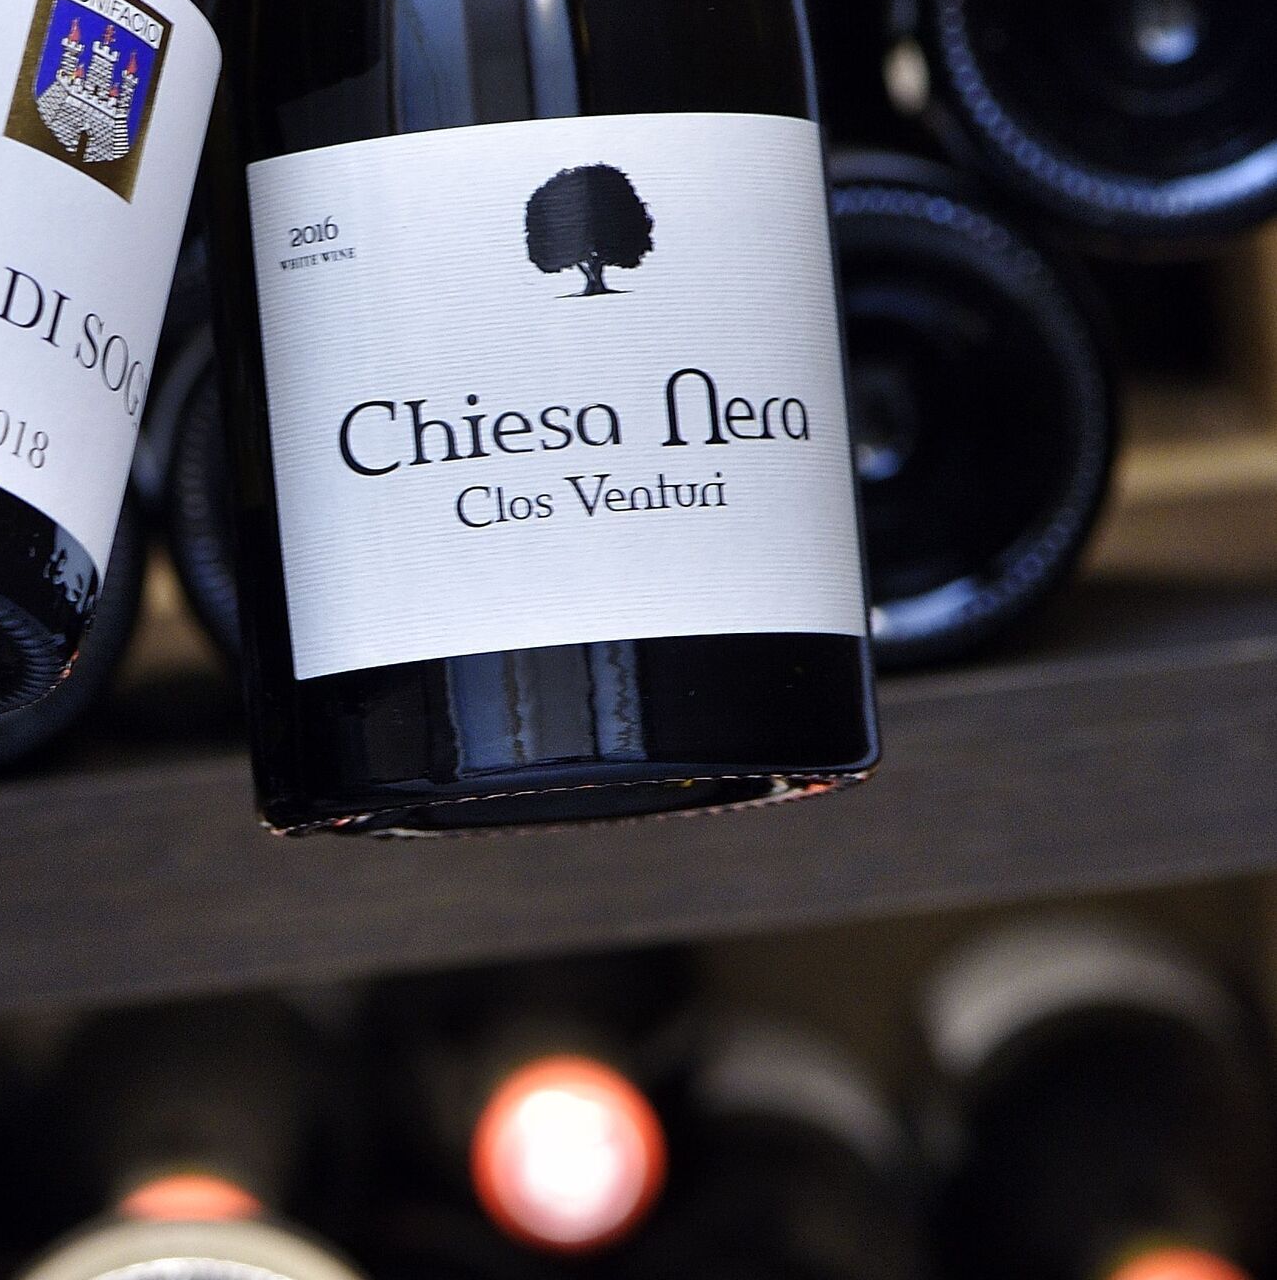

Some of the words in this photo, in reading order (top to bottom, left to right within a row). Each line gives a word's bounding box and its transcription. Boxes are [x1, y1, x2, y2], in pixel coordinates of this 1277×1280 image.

[279, 253, 320, 271] WHITE
[320, 247, 356, 262] WINE
[288, 215, 339, 247] 2016
[75, 313, 146, 427] SOG
[338, 393, 622, 476] Chiesa
[661, 367, 810, 447] Nera
[455, 485, 554, 528] Clos
[563, 471, 728, 517] Venturi
